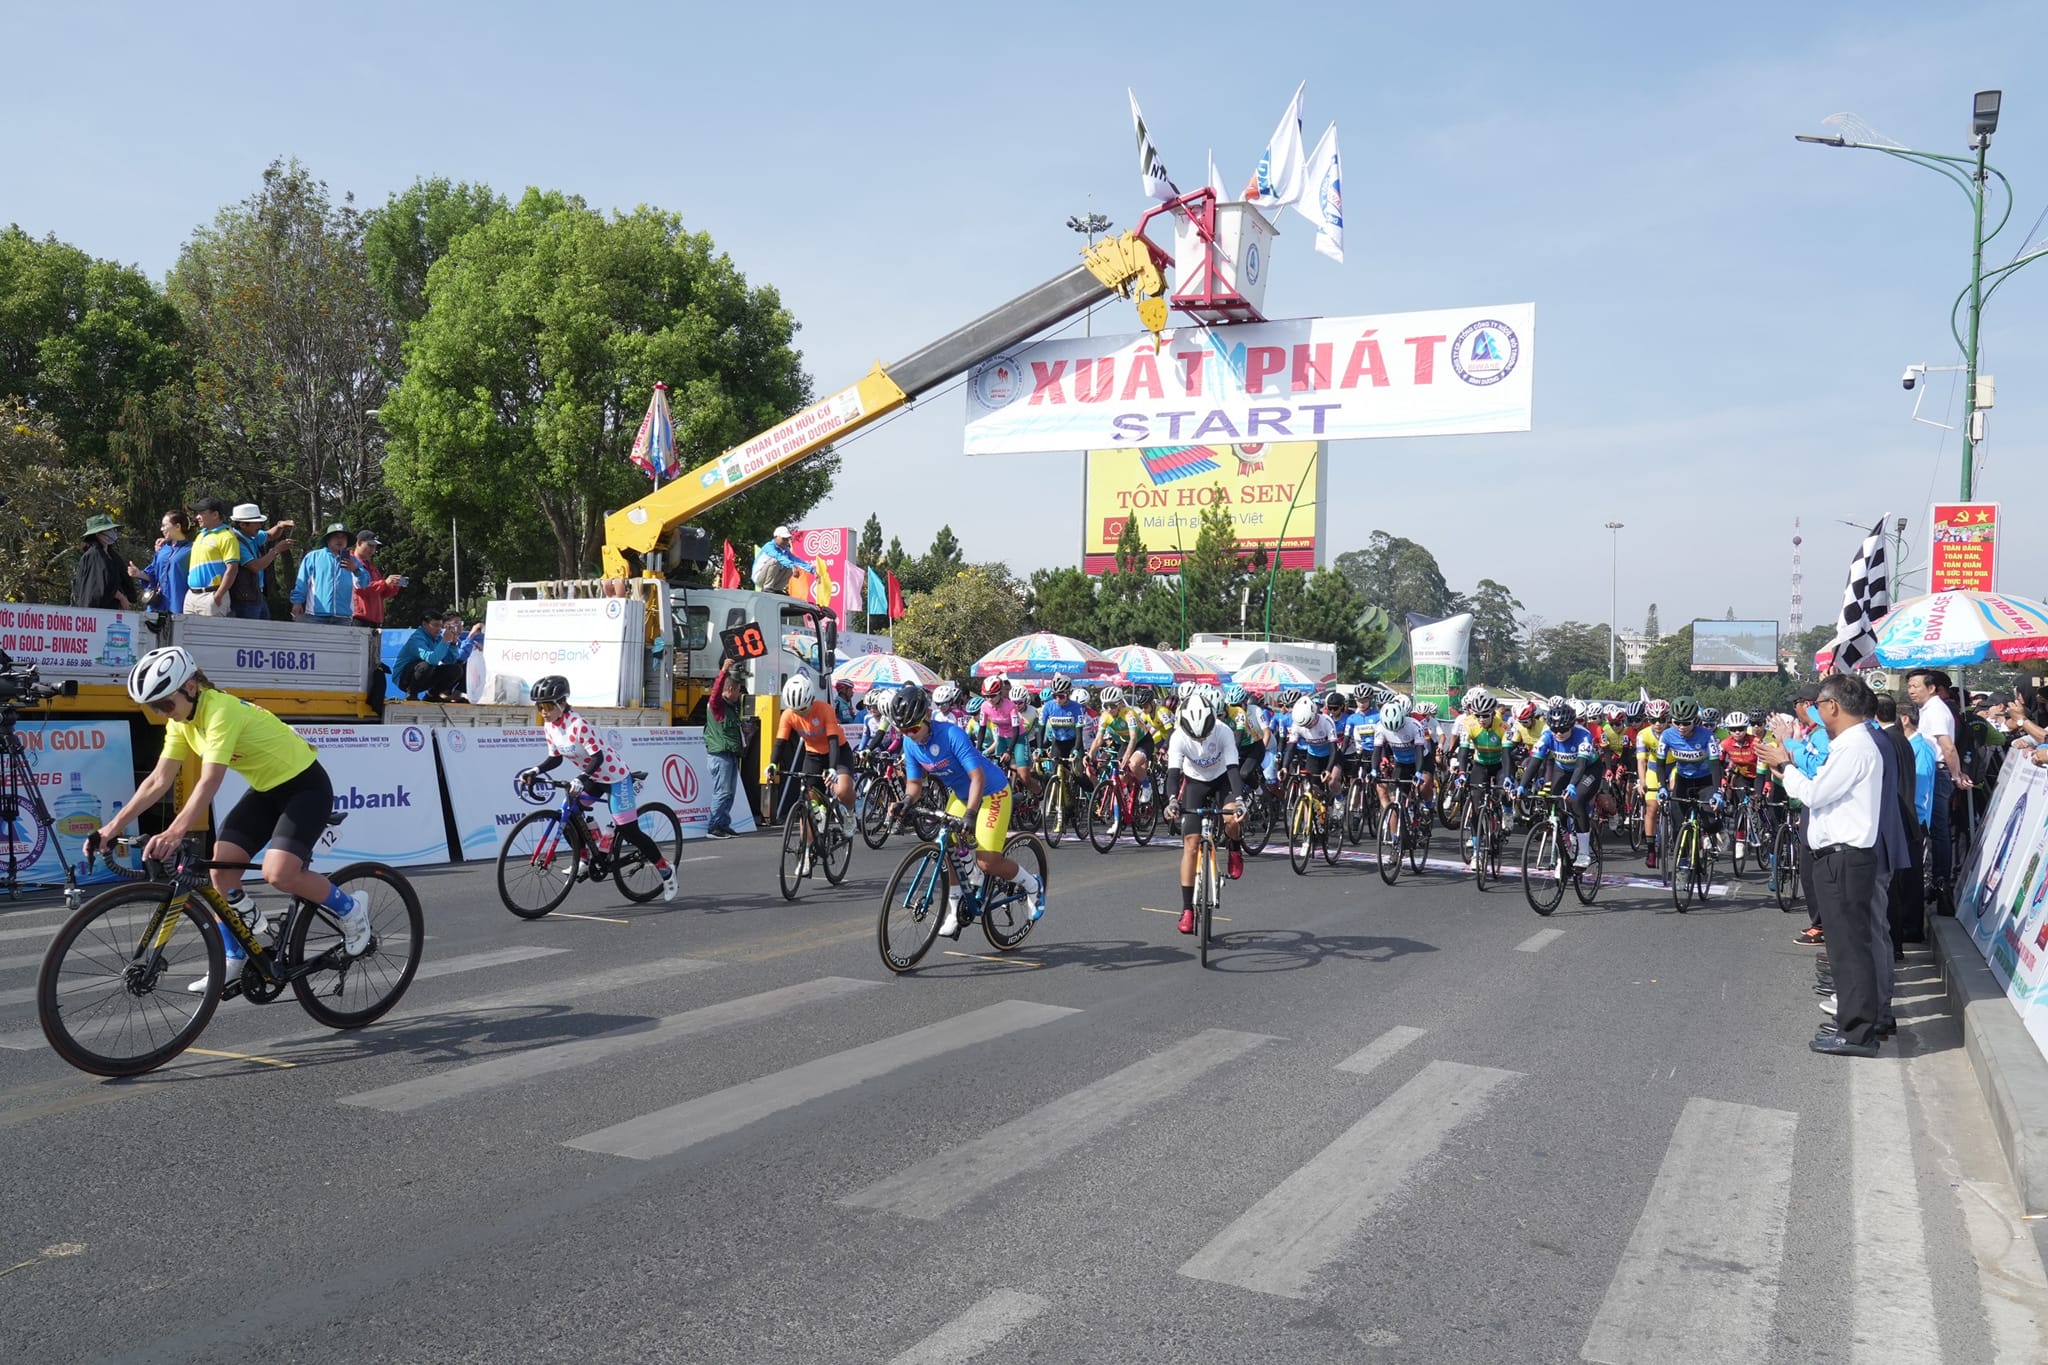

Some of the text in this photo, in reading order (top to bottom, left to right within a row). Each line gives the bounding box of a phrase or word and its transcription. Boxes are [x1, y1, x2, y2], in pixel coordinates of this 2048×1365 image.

[1028, 338, 1214, 405] XUẤT
[1245, 329, 1447, 394] PHÁT
[1111, 403, 1342, 441] START
[1117, 482, 1296, 509] TÔN HOA SEN
[1238, 511, 1264, 526] Việt
[804, 530, 842, 556] GO!
[18, 608, 44, 629] UỐNG
[46, 612, 72, 631] ĐÓNG
[75, 616, 96, 632] CHAI
[1924, 595, 1954, 641] BIWASE
[734, 628, 765, 657] 10
[60, 658, 65, 666] 3
[236, 649, 316, 670] 61C-168.81
[502, 648, 590, 664] KienlongBank
[50, 730, 106, 750] GOLD
[320, 830, 338, 848] 12
